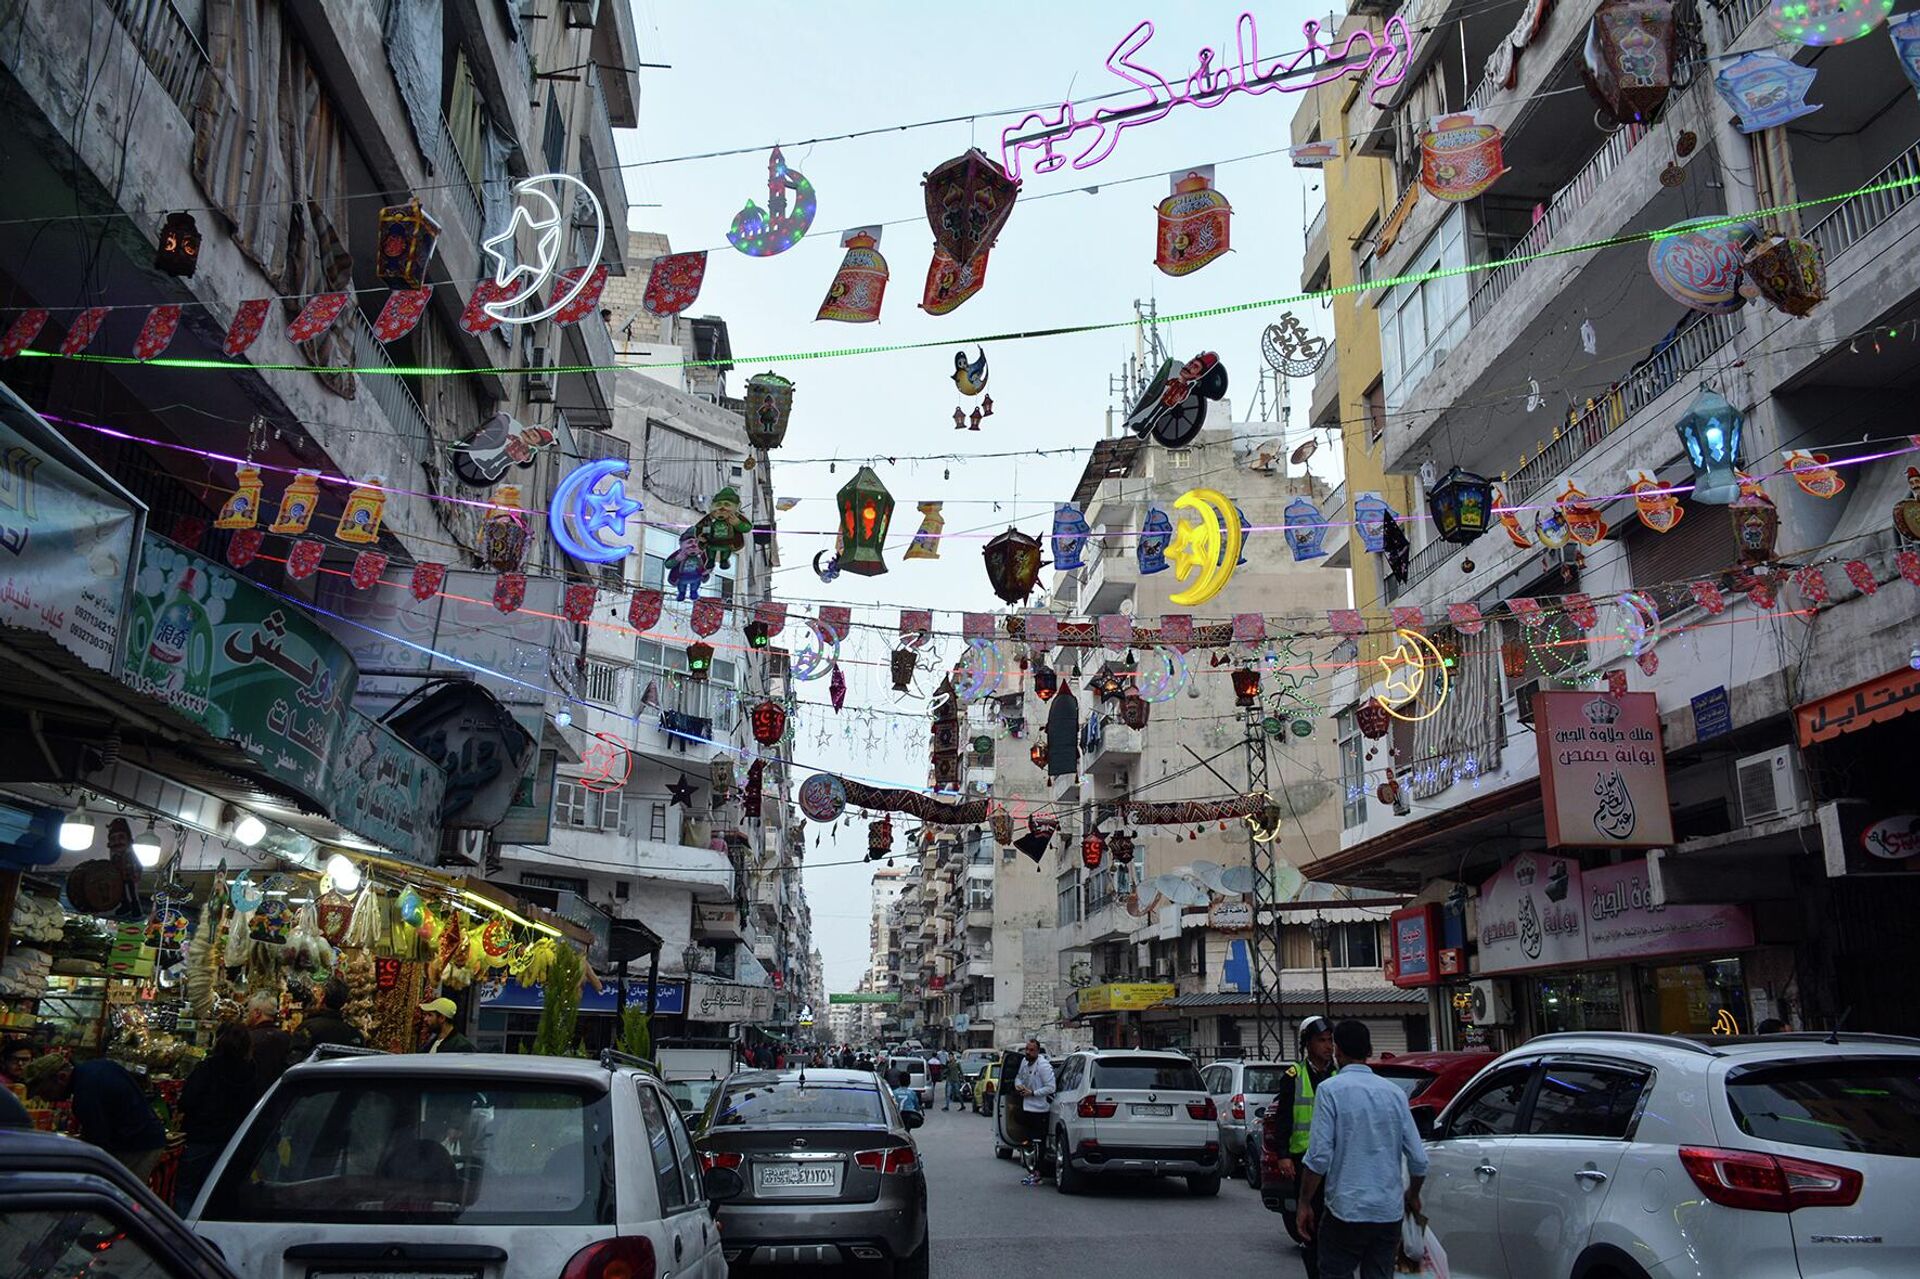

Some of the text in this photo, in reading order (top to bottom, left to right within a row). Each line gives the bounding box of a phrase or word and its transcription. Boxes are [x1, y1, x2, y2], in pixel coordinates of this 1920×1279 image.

[157, 624, 189, 649] 浪奇
[1554, 726, 1654, 744] ملك حلاوة الجبن
[1558, 744, 1656, 766] بوابة حمص
[1591, 880, 1629, 920] الجبن
[1543, 907, 1580, 939] بوابة
[898, 1095, 908, 1111] 7
